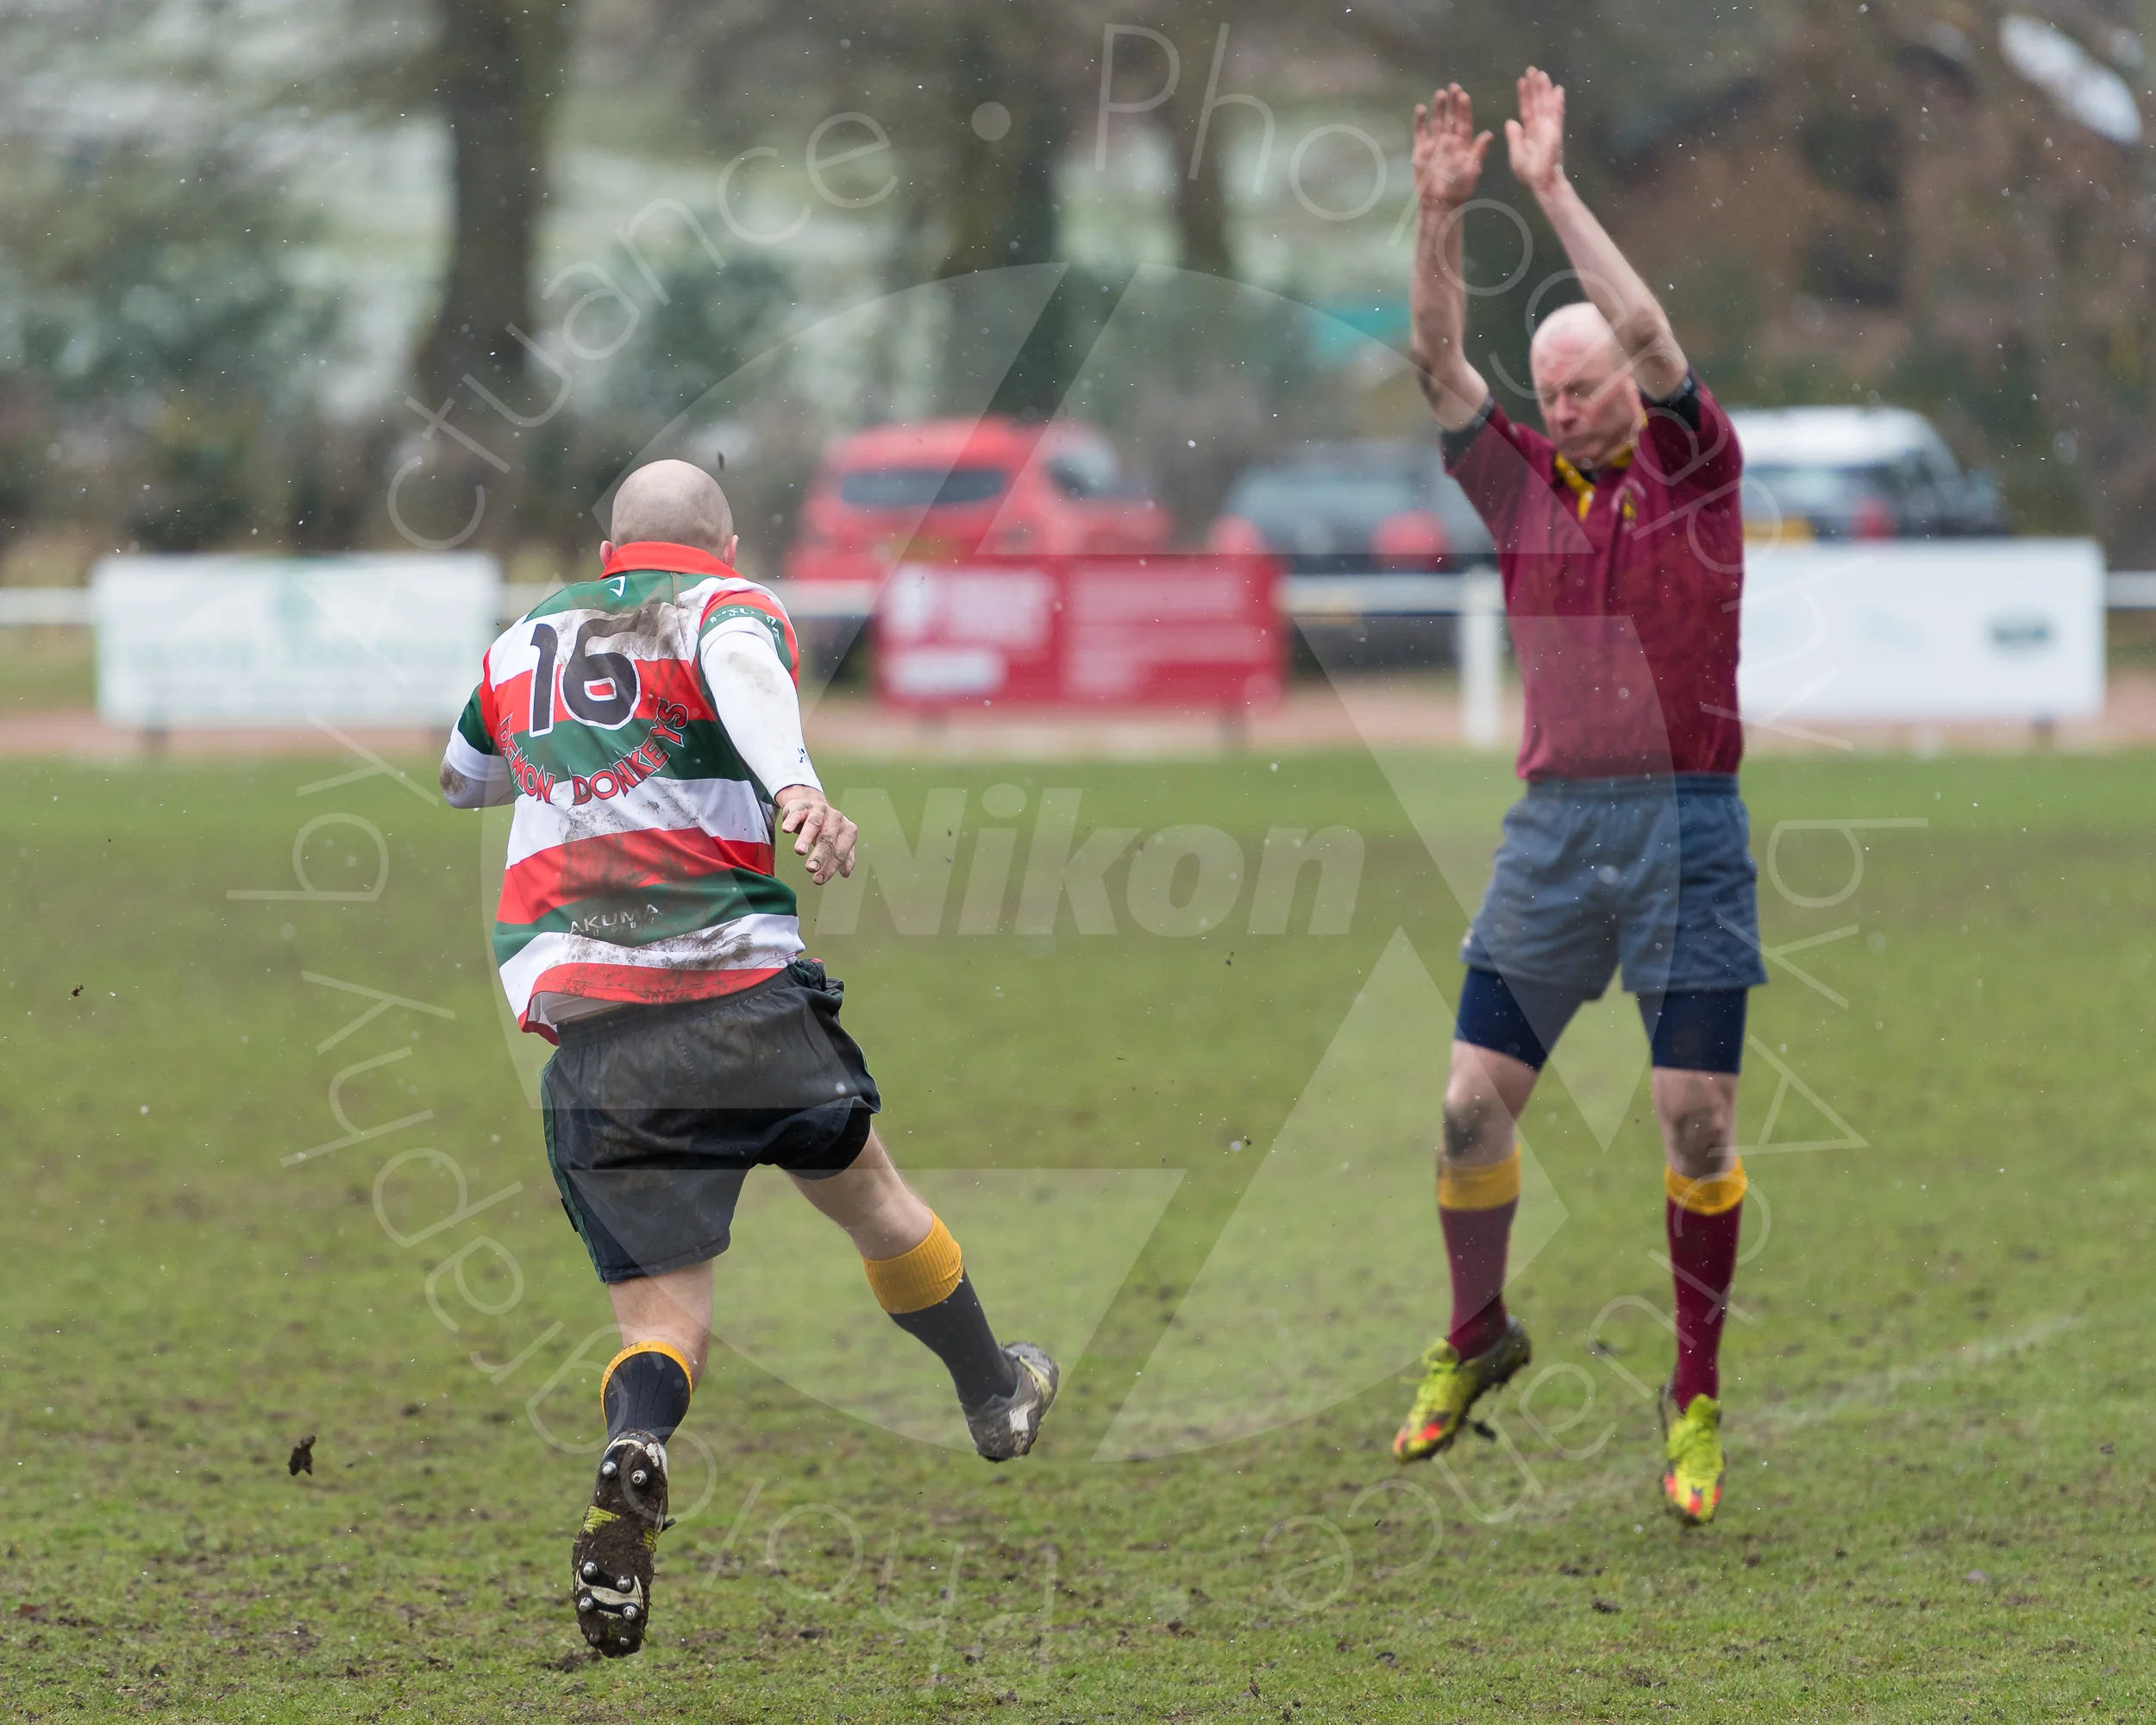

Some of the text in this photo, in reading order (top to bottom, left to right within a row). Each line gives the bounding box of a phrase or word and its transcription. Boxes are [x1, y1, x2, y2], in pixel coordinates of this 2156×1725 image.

[530, 619, 642, 737] 16
[567, 697, 688, 806] DONKEYS
[569, 904, 662, 934] AKUMA
